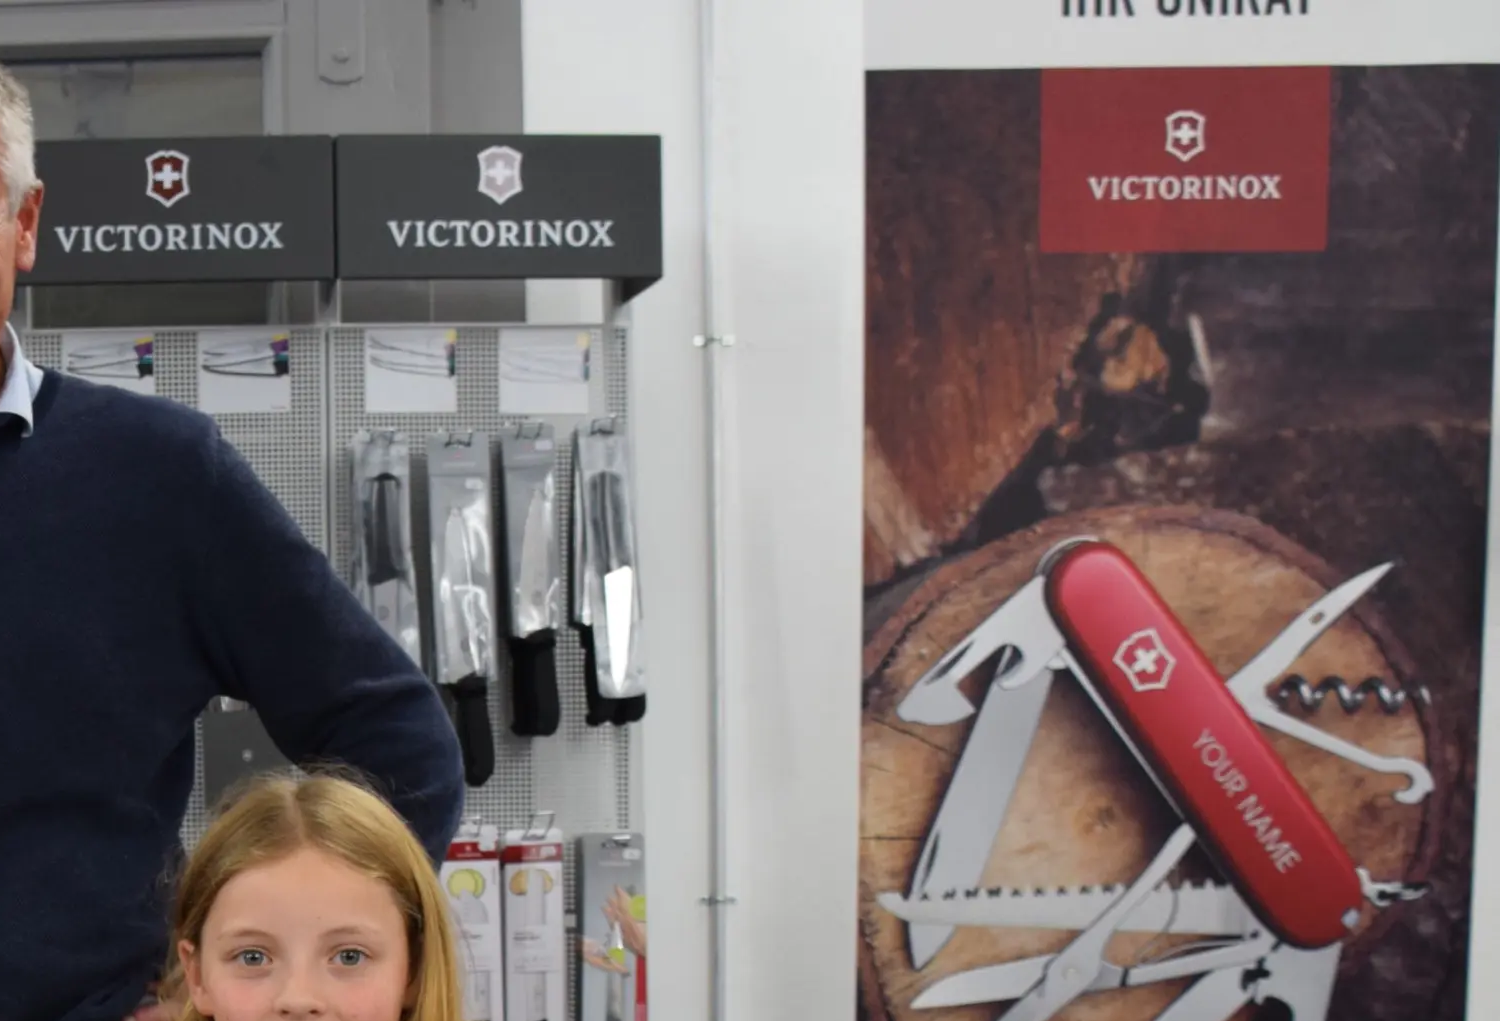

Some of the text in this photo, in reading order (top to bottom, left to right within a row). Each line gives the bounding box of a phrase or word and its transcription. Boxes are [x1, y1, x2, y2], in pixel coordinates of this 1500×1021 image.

[1087, 174, 1283, 201] VICTORINOX
[54, 221, 284, 253] VICTORINOX
[387, 219, 615, 249] VICTORINOX
[1192, 727, 1303, 874] YOUR NAME
